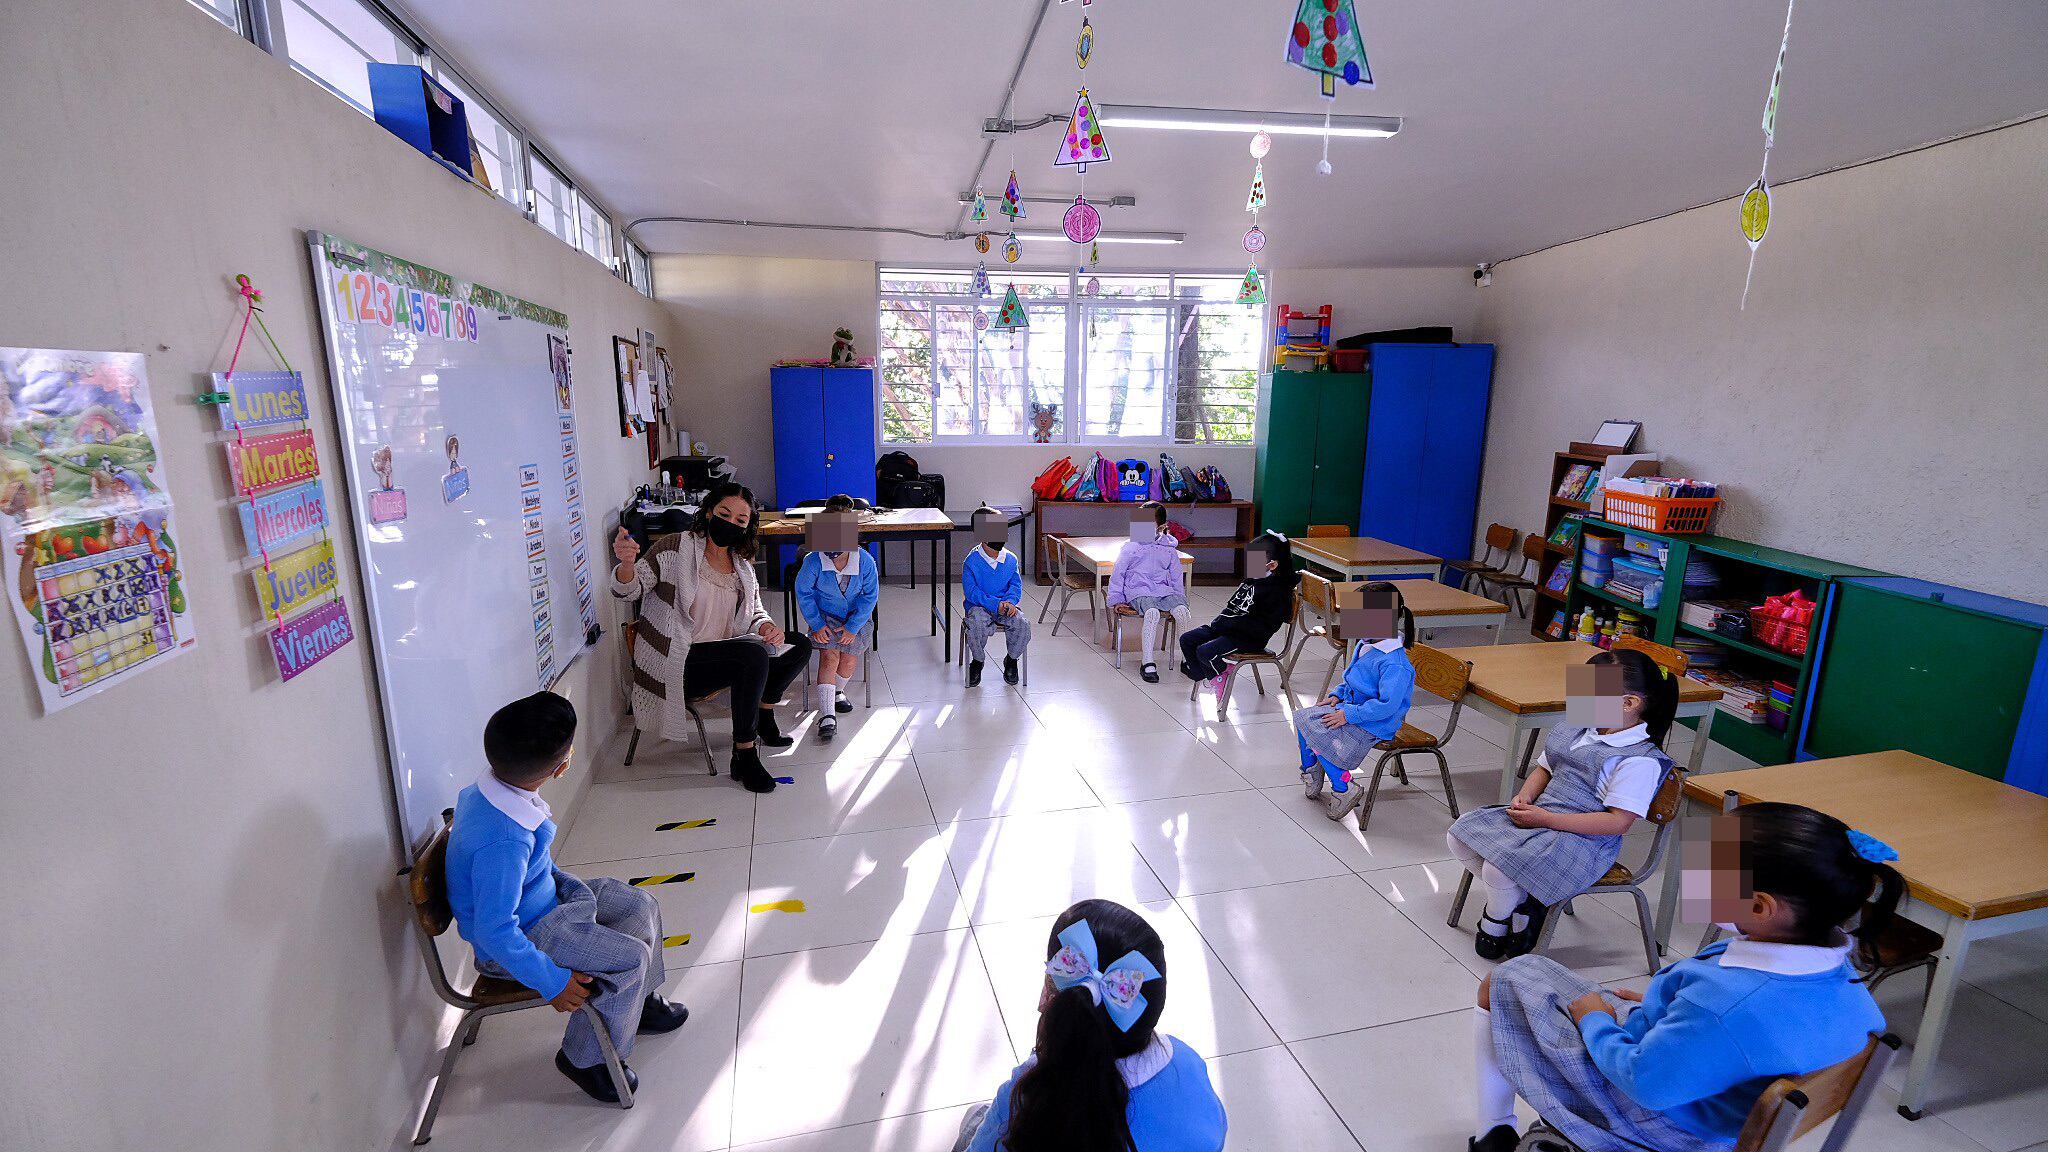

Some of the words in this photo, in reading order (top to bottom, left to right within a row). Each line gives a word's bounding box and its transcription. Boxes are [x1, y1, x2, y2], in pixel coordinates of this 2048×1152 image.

[229, 383, 302, 421] Lunes
[239, 444, 316, 487] Martes
[253, 497, 325, 546] Miércoles
[268, 555, 337, 611] Jueves
[277, 614, 349, 669] Viernes
